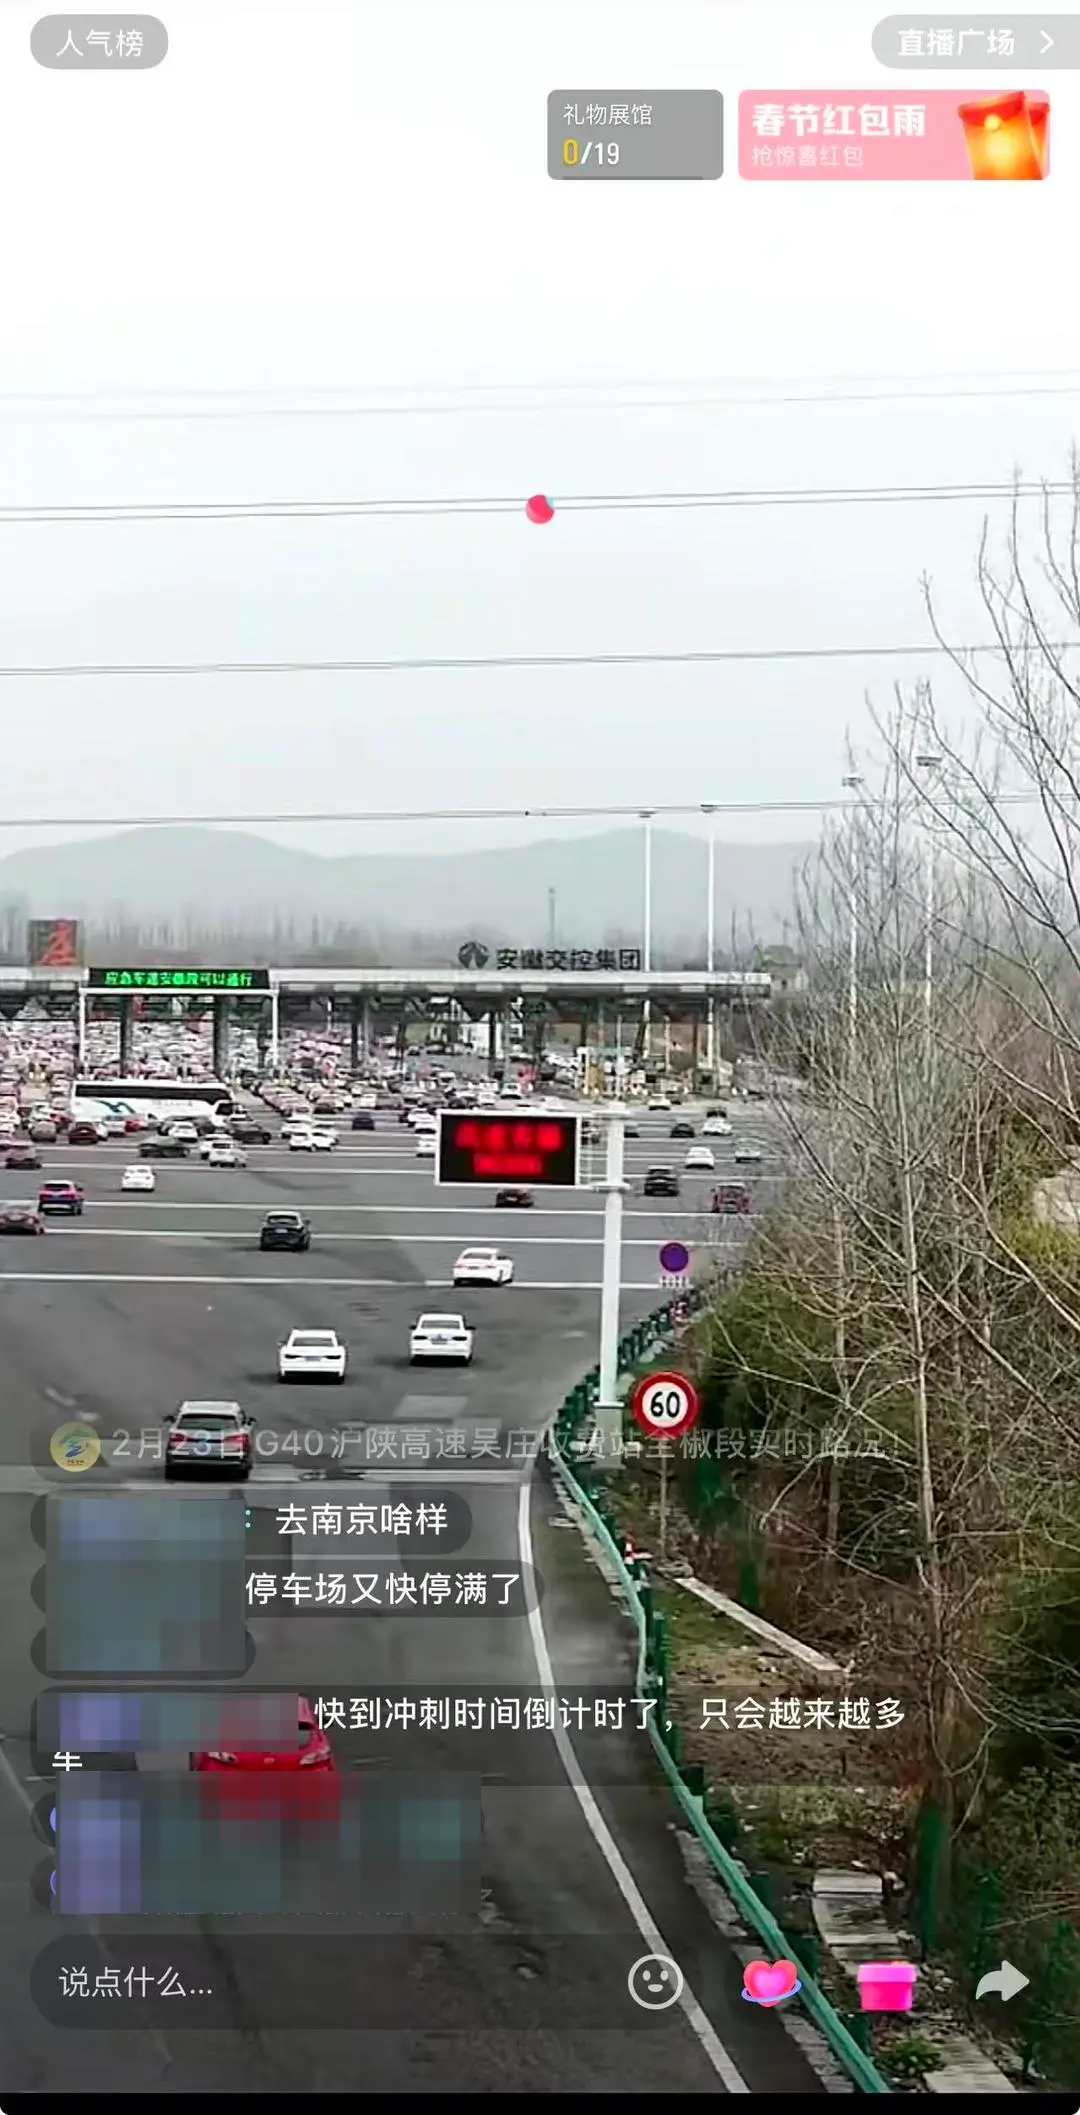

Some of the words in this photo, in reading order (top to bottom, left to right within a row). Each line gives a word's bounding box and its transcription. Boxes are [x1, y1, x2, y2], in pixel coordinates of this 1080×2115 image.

[497, 948, 641, 972] 安徽交控集团
[650, 1391, 681, 1419] 60
